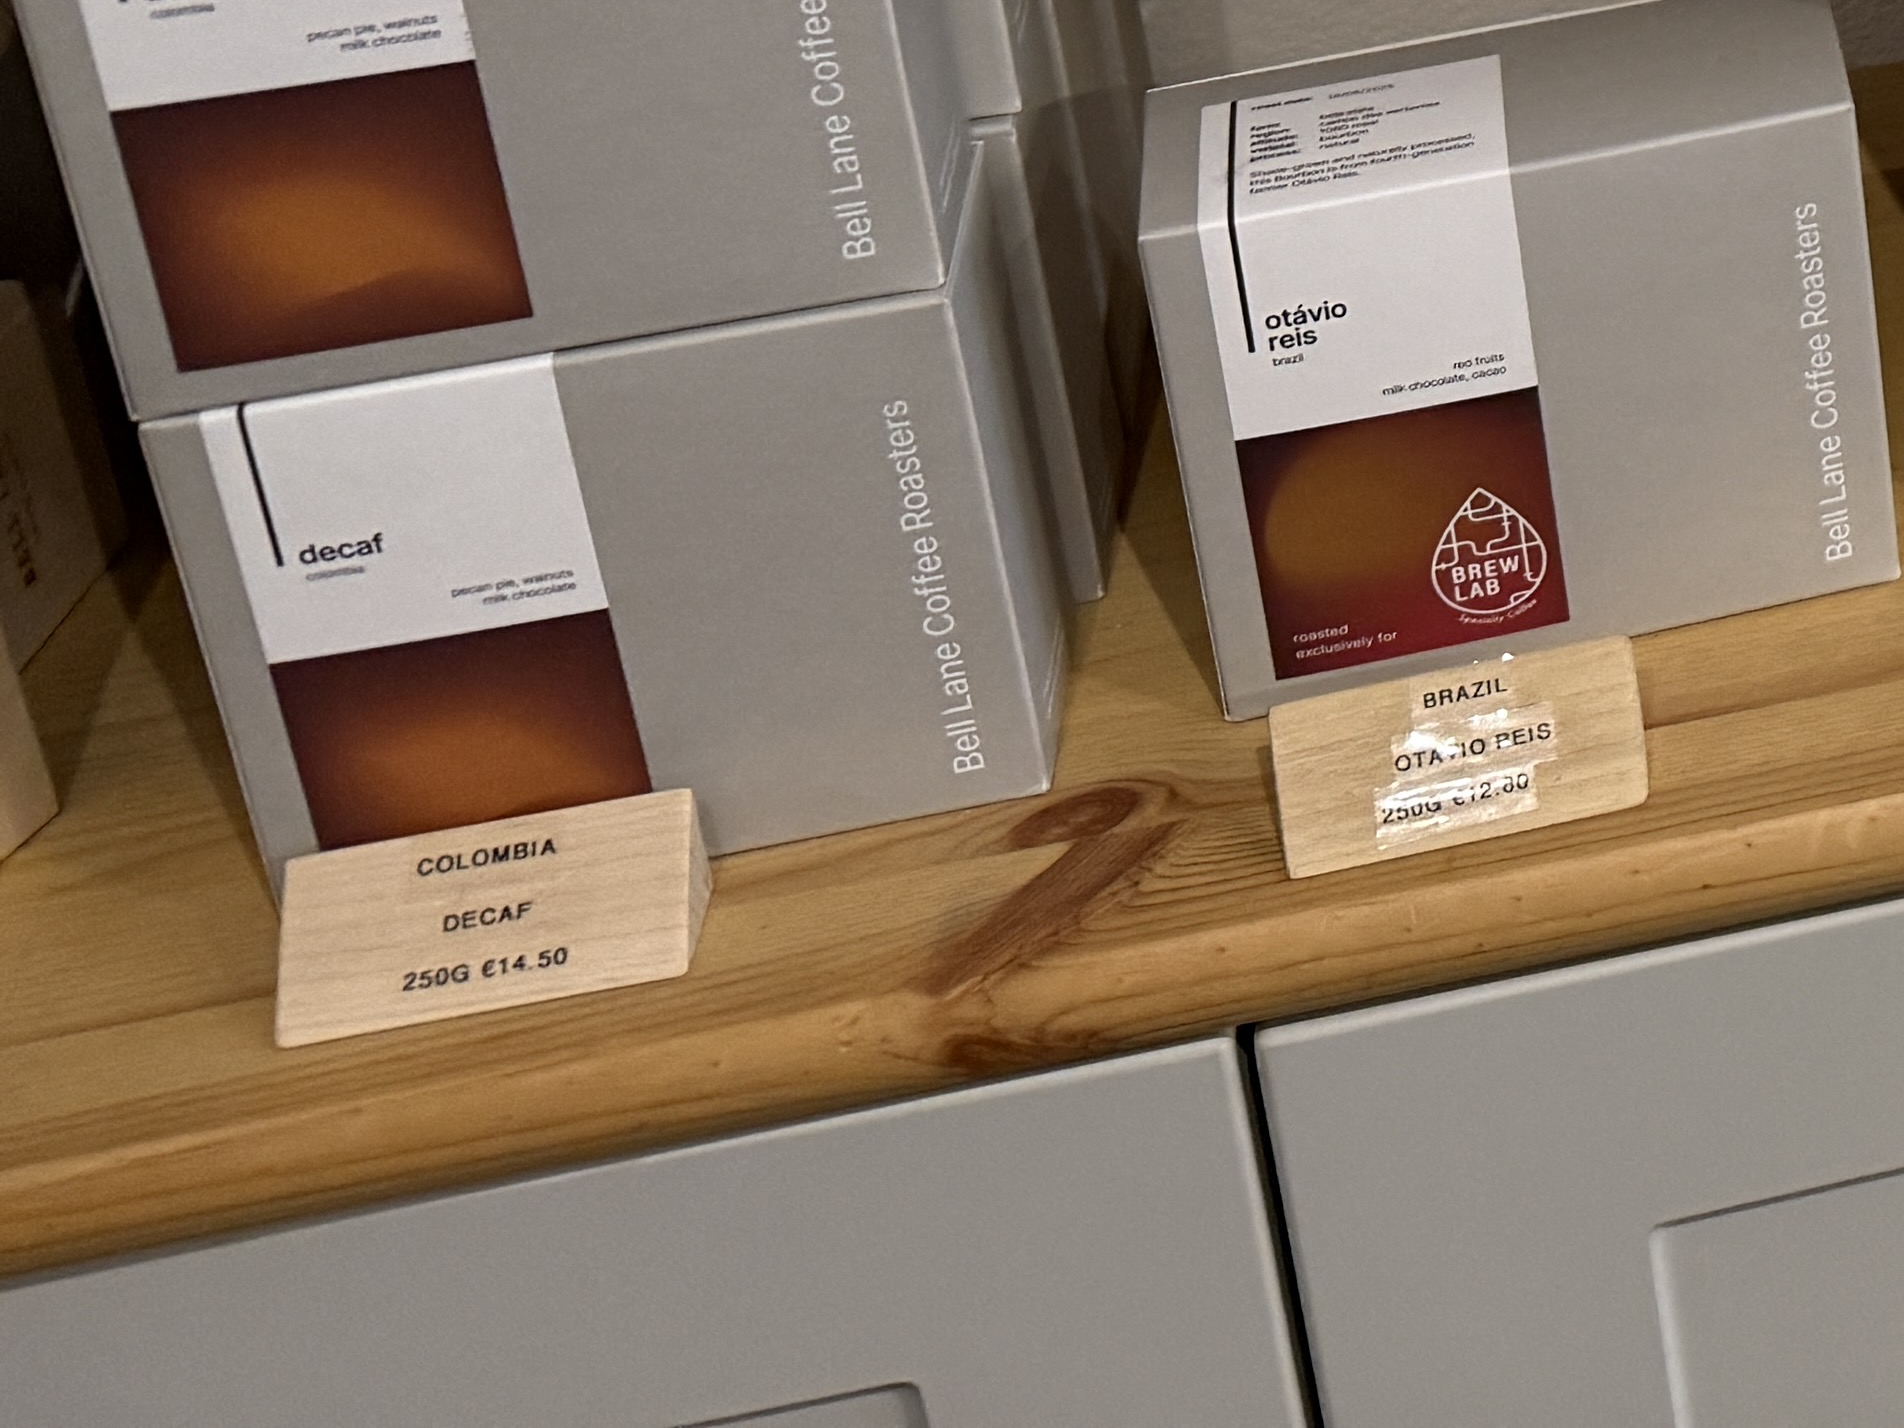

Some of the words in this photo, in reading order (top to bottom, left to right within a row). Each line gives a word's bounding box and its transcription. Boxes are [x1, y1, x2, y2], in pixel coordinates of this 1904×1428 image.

[306, 25, 351, 43] pecan
[371, 28, 442, 47] chocolate
[825, 114, 864, 195] Lane
[834, 201, 876, 260] Bell
[1796, 202, 1829, 329] Roasters
[1265, 300, 1347, 330] otávio
[1268, 327, 1318, 352] reis
[1272, 353, 1304, 367] brazil
[1475, 352, 1505, 366] fruits
[1382, 384, 1407, 396] milk
[1408, 373, 1469, 392] chocolate,
[1472, 366, 1507, 381] cacao
[1805, 333, 1838, 429] Coffee
[883, 399, 933, 532] Roasters
[1819, 434, 1846, 505] Lane
[299, 532, 384, 565] decaf
[1821, 507, 1852, 562] Bell
[1451, 554, 1519, 584] BREW
[451, 582, 492, 598] pecan
[511, 580, 577, 601] chocolate
[911, 535, 955, 637] Coffee
[1454, 579, 1501, 602] LAB
[1293, 624, 1349, 644] roasted
[1296, 634, 1375, 660] exclusively
[1378, 630, 1398, 644] for
[935, 642, 973, 717] Lane
[1423, 678, 1508, 709] BRAZIL
[943, 719, 986, 775] Bell
[417, 838, 557, 876] COLOMBIA
[442, 901, 533, 933] DECAF
[402, 964, 470, 991] 250G
[481, 947, 568, 978] €14.50
